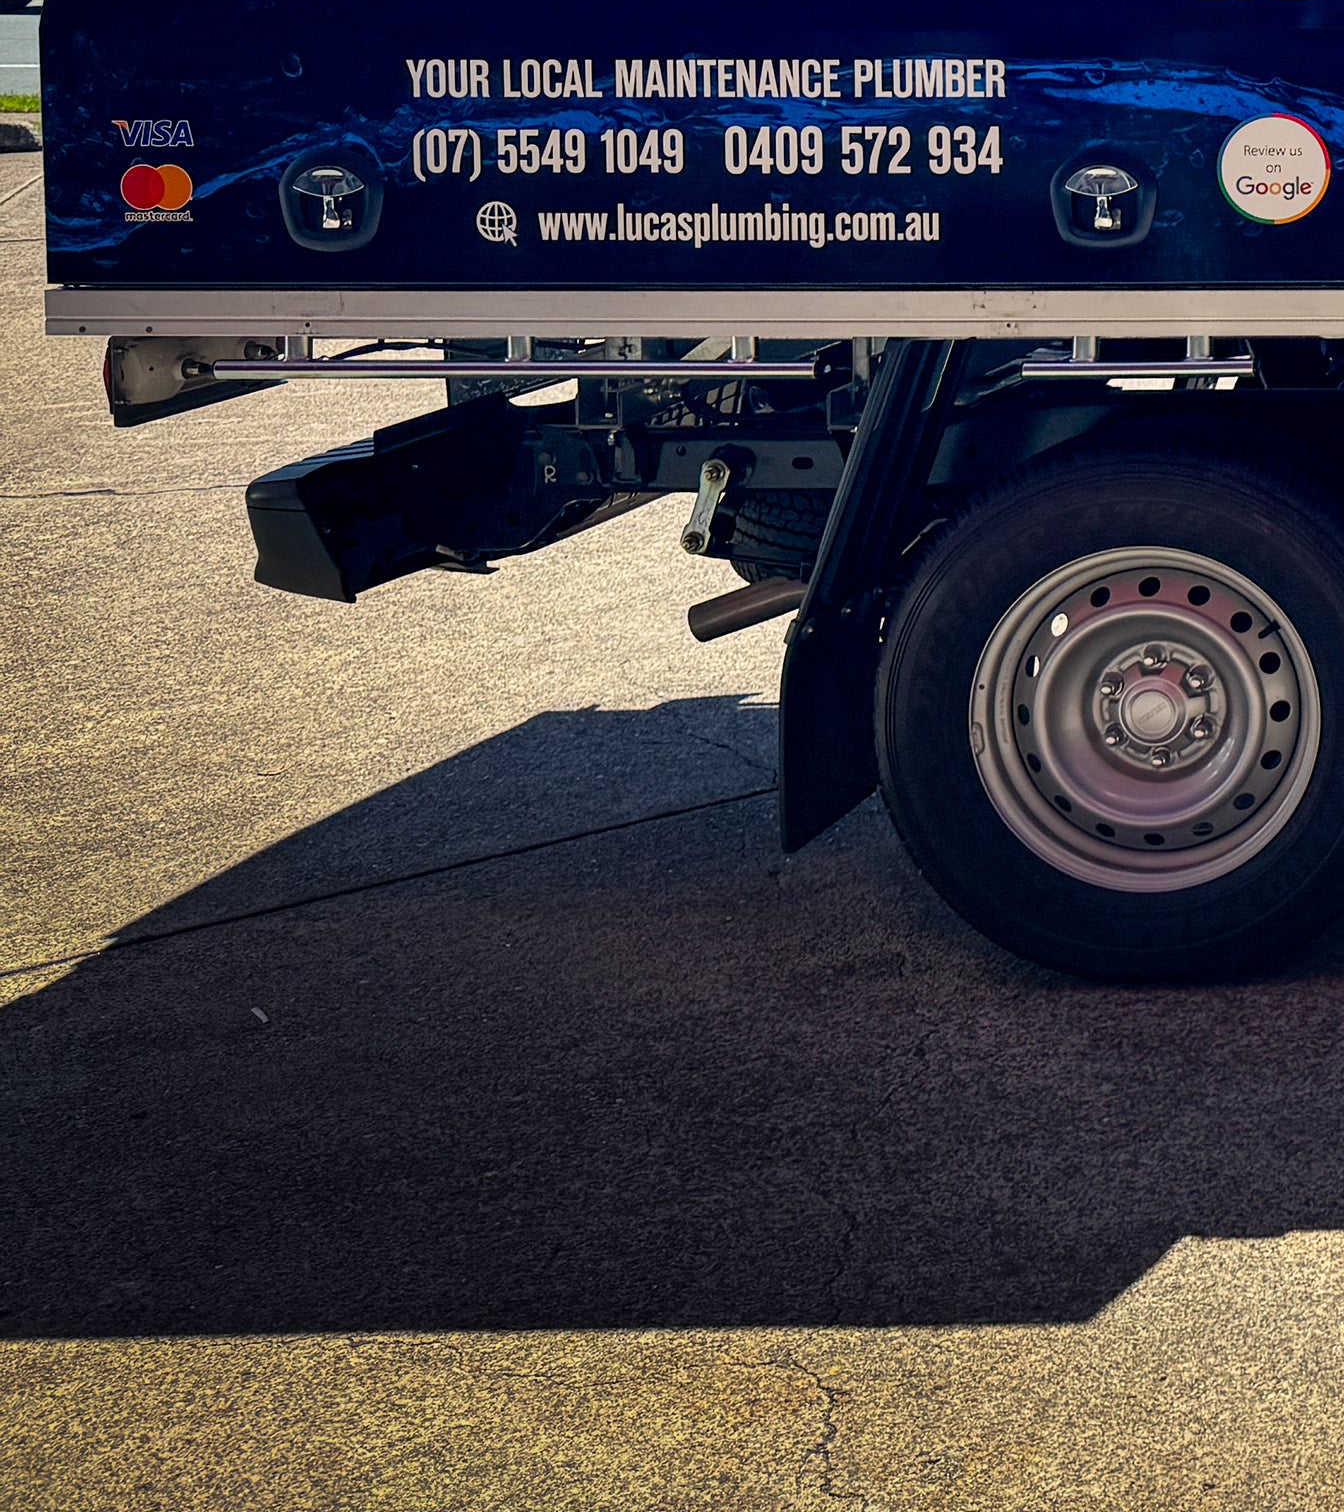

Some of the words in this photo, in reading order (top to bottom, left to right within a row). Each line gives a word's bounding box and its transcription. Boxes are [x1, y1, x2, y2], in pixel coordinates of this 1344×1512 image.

[405, 59, 490, 99] YOUR
[503, 59, 603, 99] LOCAL
[615, 58, 840, 99] MAINTENANCE
[854, 59, 1006, 99] PLUMBER
[111, 119, 195, 147] VISA
[724, 125, 822, 175] 0409
[841, 125, 911, 175] 572
[928, 125, 1004, 175] 934
[413, 128, 481, 182] (07)
[497, 128, 586, 174] 5549
[600, 128, 684, 174] 1049
[1243, 144, 1286, 157] Review
[1289, 147, 1303, 157] us
[1265, 164, 1282, 174] on
[1236, 175, 1312, 201] Google
[537, 203, 940, 249] www.lucasplumbing.com.au
